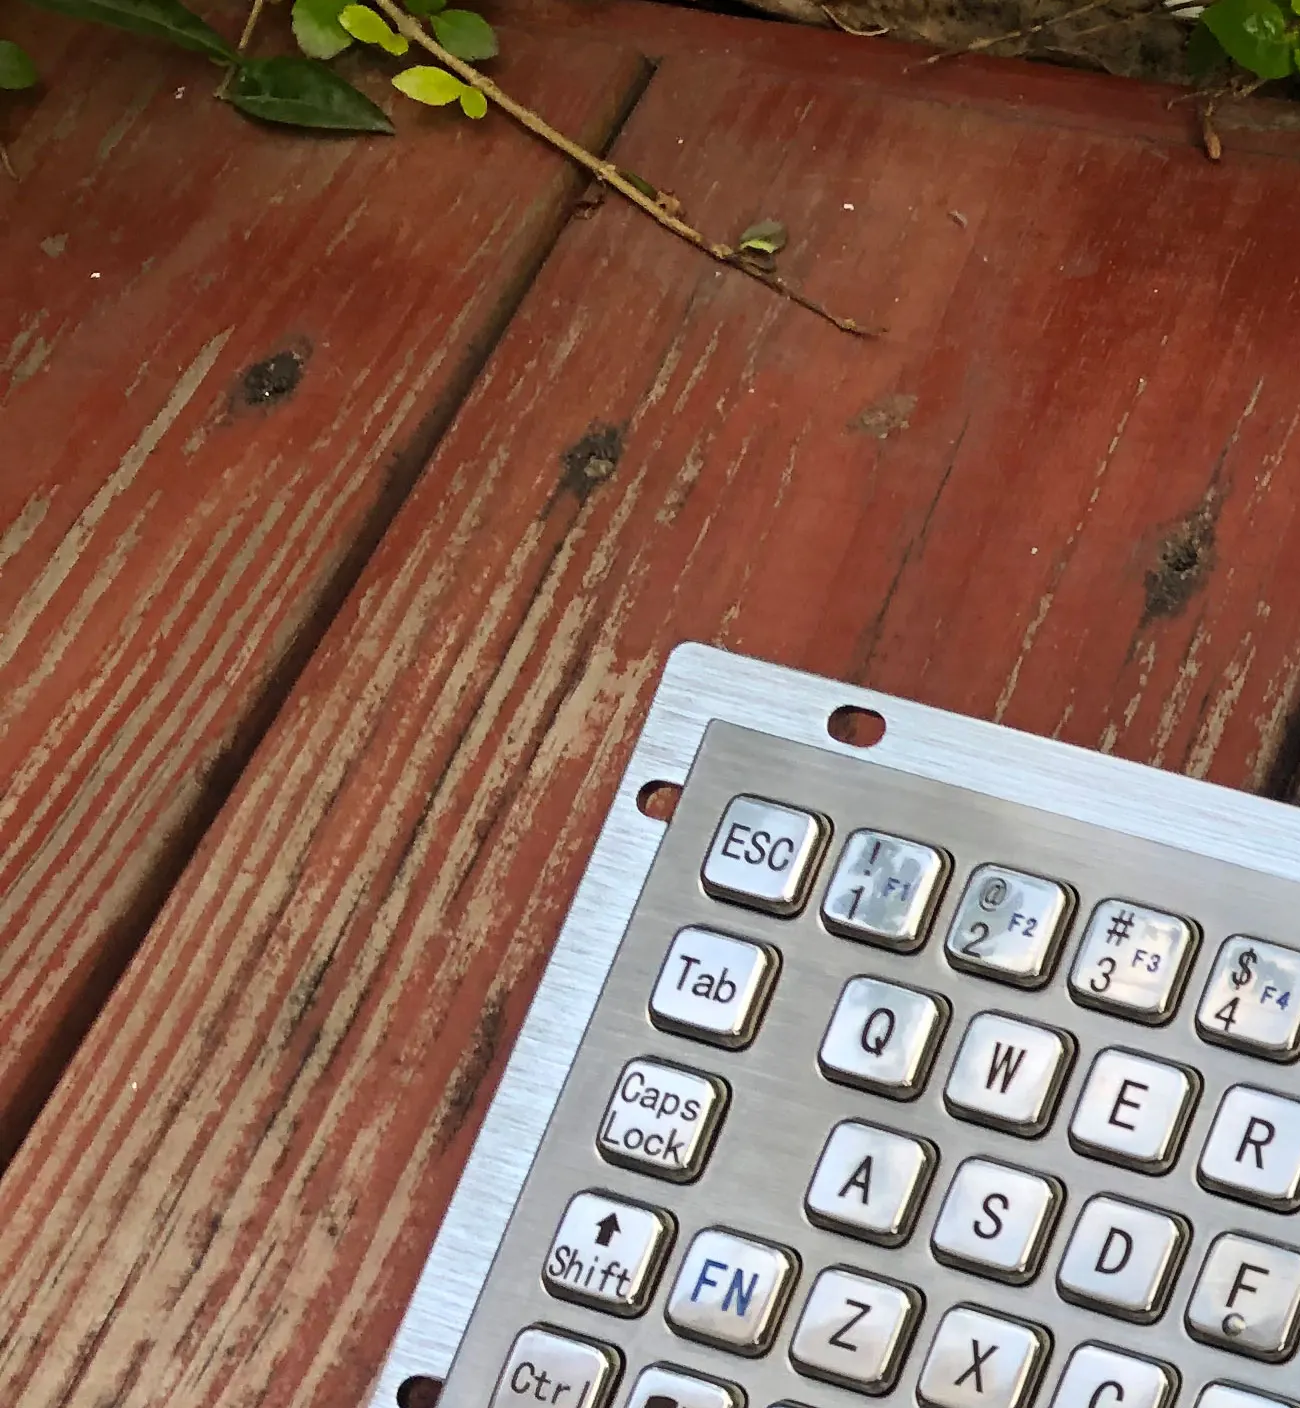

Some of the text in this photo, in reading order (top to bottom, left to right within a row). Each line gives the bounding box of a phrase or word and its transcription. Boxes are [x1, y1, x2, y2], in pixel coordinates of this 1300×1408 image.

[721, 822, 795, 872] ESC
[863, 840, 881, 877] !
[847, 885, 866, 920] 1
[881, 876, 912, 902] F1
[978, 876, 1010, 912] @
[963, 920, 990, 958] 2
[1007, 913, 1039, 939] F2
[1104, 909, 1136, 949] #
[677, 954, 738, 1004] Tab
[1089, 957, 1116, 994] 3
[1130, 948, 1162, 974] F3
[1231, 947, 1259, 991] $
[1213, 997, 1238, 1035] 4
[1259, 984, 1293, 1011] F4
[860, 1006, 897, 1056] Q
[985, 1040, 1027, 1095] W
[620, 1071, 701, 1123] Caps
[1106, 1078, 1150, 1132] E
[600, 1109, 688, 1164] Lock
[1234, 1115, 1275, 1170] R
[837, 1154, 873, 1206] A
[973, 1192, 1011, 1240] S
[547, 1244, 632, 1298] Shift
[1093, 1226, 1134, 1275] D
[689, 1258, 761, 1317] FN
[1226, 1261, 1271, 1309] F
[828, 1299, 871, 1353] Z
[953, 1337, 999, 1394] X
